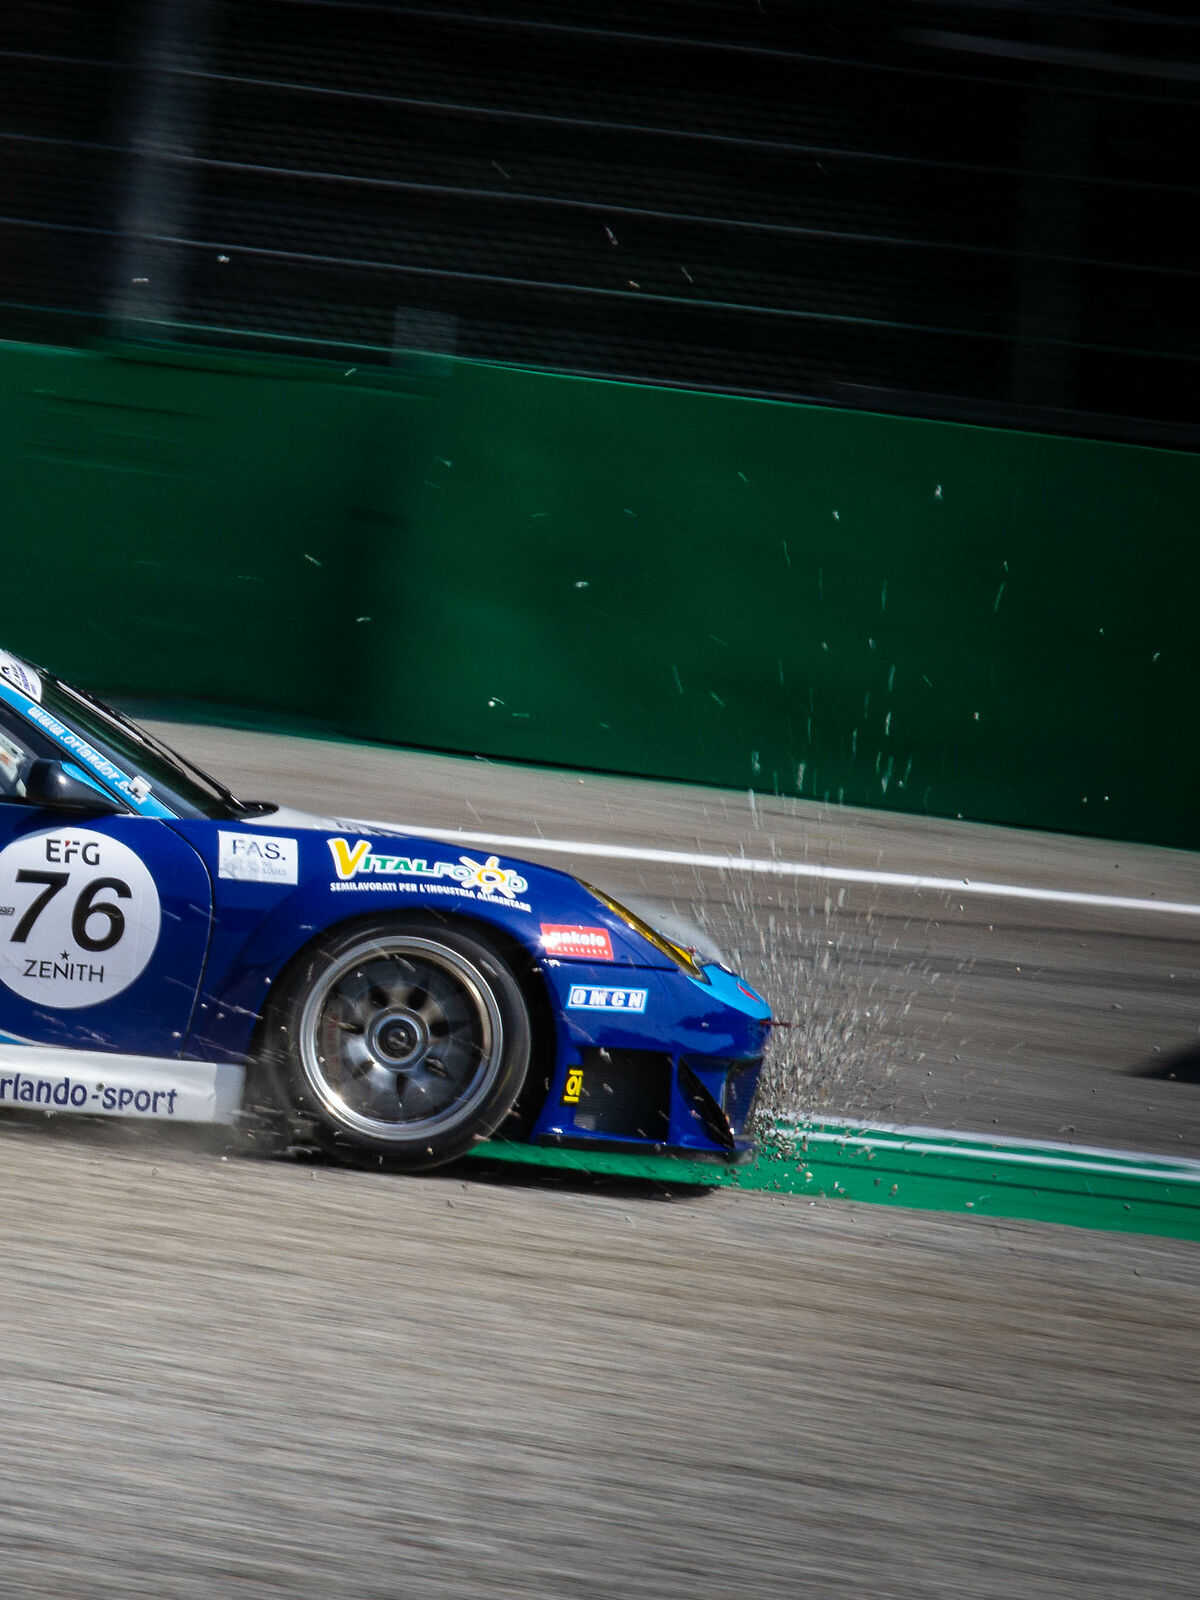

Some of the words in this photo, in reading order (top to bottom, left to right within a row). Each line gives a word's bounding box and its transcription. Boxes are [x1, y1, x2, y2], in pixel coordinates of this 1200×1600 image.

[46, 838, 100, 866] EFG
[330, 882, 397, 892] SEMILAVORATI
[398, 883, 418, 892] PER
[420, 884, 476, 899] L'INDUSTRIA
[10, 868, 133, 953] 76
[22, 959, 105, 983] ZENITH
[572, 989, 643, 1008] OMCN
